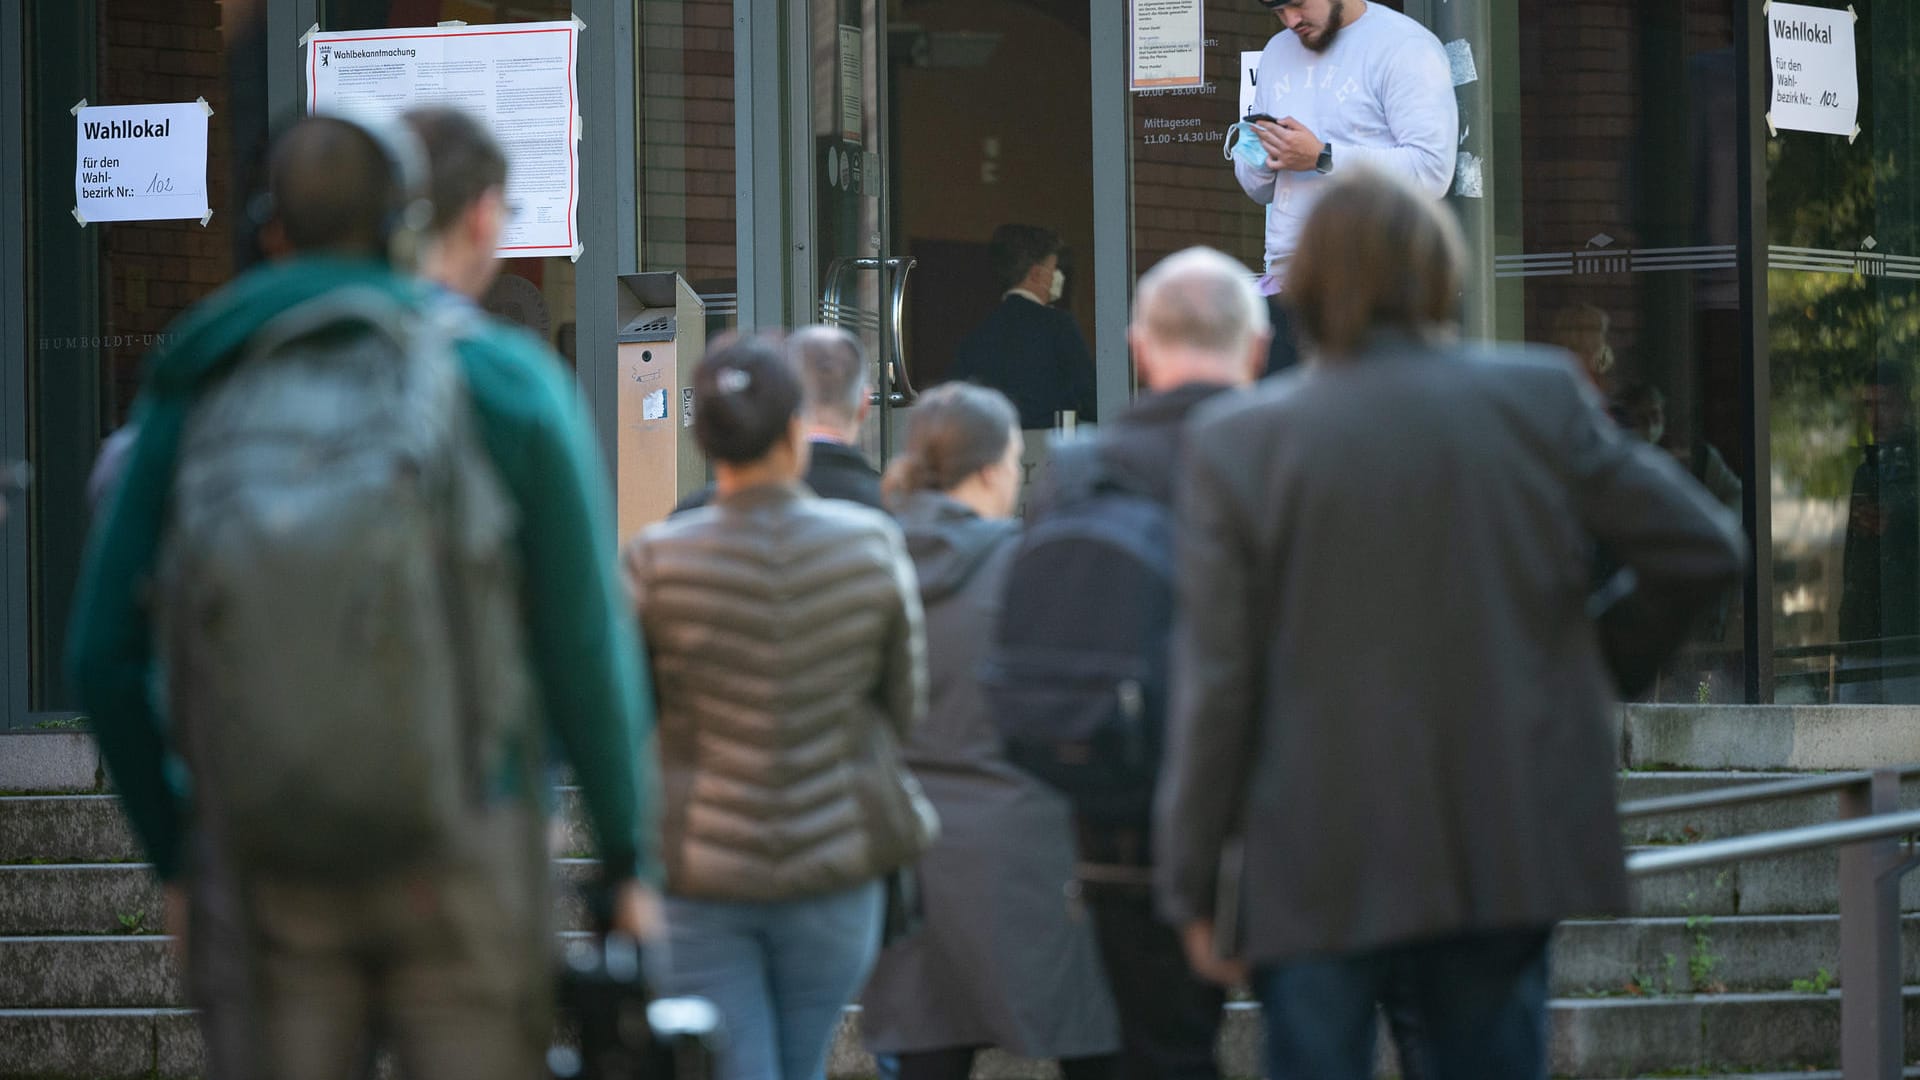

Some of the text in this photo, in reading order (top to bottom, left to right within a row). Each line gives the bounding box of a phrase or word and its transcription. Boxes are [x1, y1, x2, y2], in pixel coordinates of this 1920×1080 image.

[1774, 19, 1832, 44] Wahllokal
[334, 47, 416, 60] Wahlbekanntmachung
[1776, 57, 1802, 72] für den
[1777, 73, 1797, 87] Wahl-
[1777, 90, 1839, 108] bezirk Nr.: 102
[84, 118, 170, 140] Wahllokal
[1144, 118, 1201, 129] Mittagessen
[1144, 135, 1170, 144] 11.00
[1178, 133, 1203, 143] 14.30
[1205, 131, 1223, 141] Uhr
[83, 156, 120, 169] für den
[82, 171, 112, 184] Wahl-
[82, 173, 174, 199] bezirk Nr.: 102
